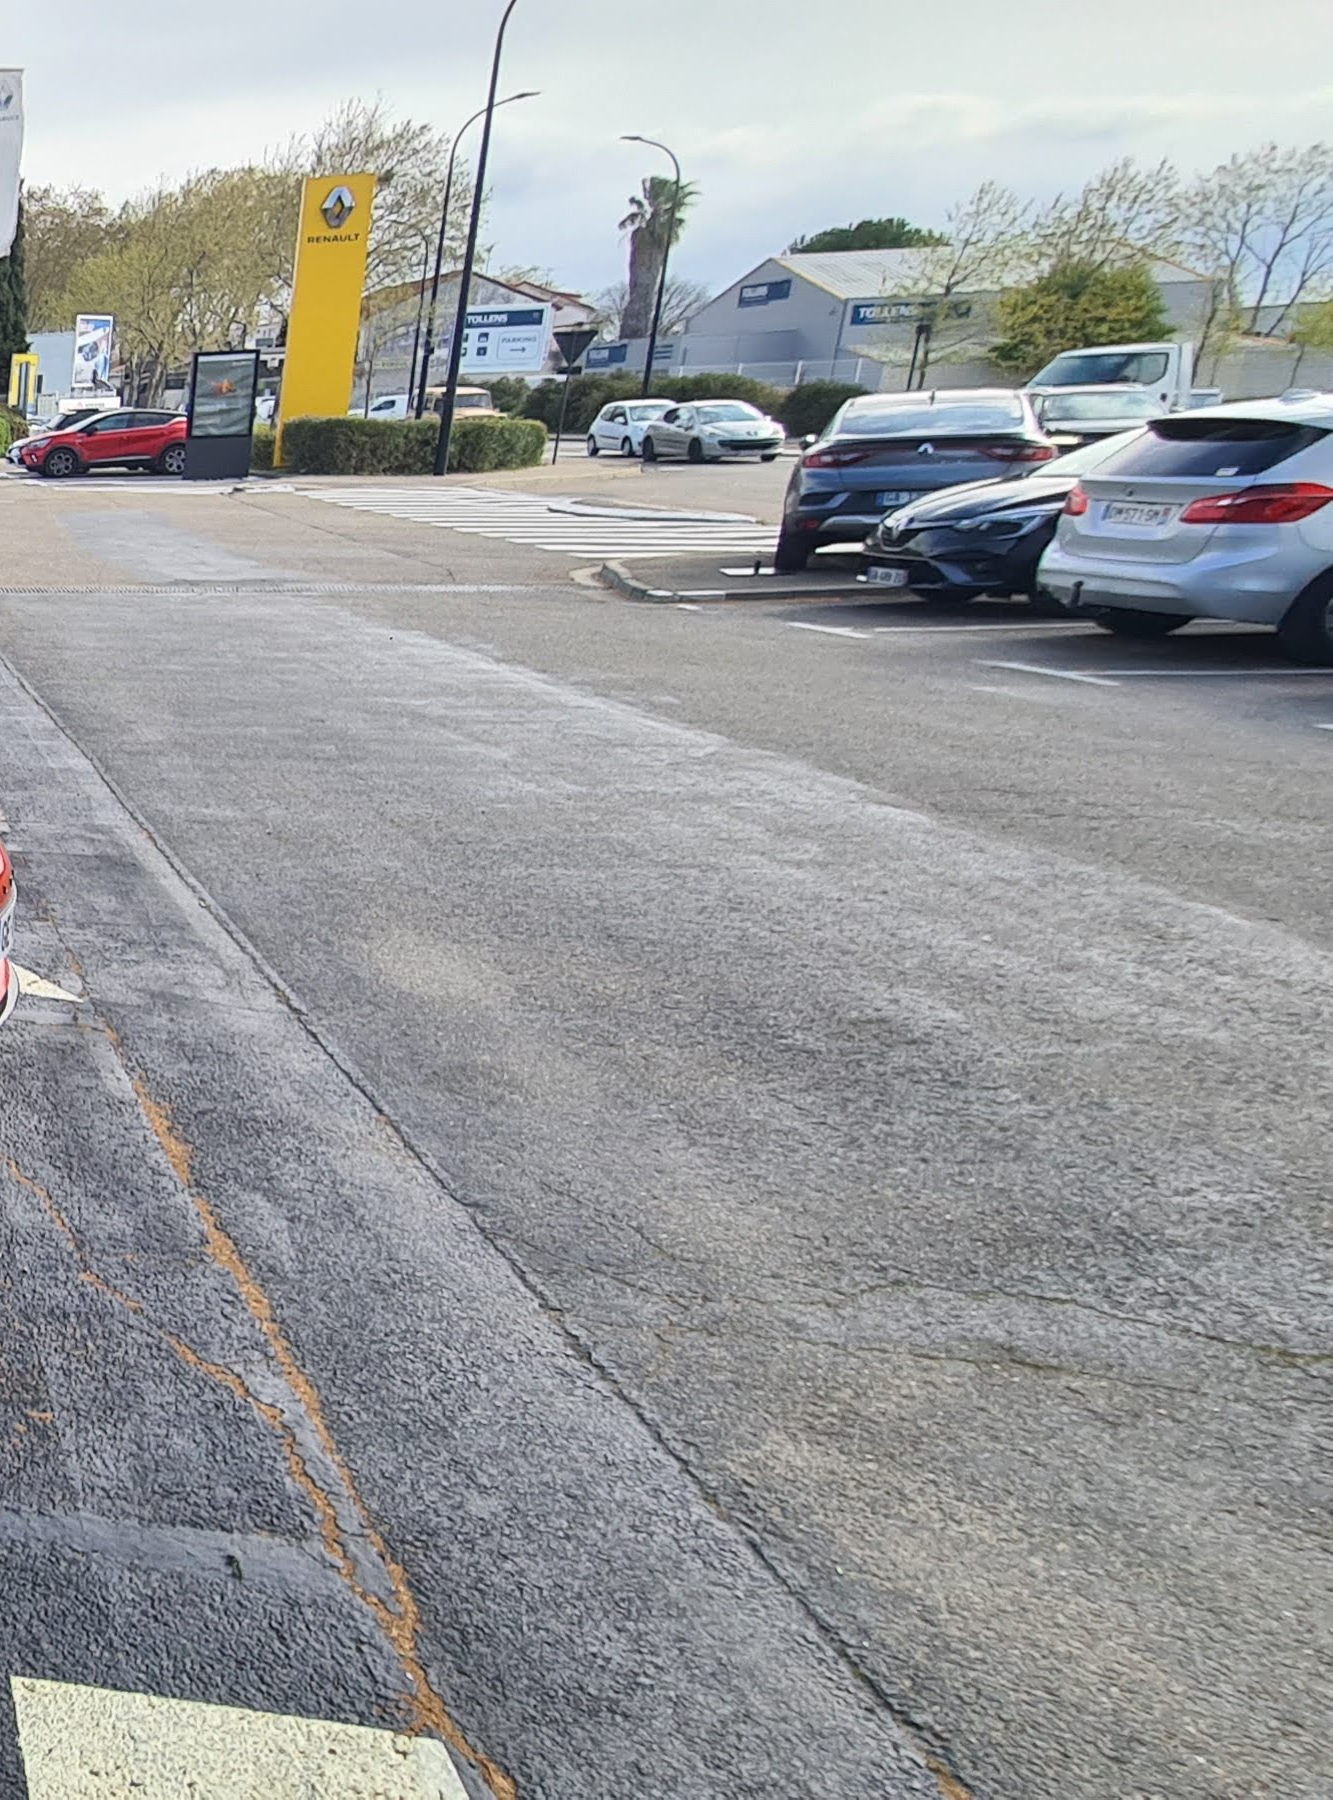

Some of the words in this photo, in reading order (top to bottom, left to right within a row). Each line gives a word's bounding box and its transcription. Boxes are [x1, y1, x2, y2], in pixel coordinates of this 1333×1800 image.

[307, 233, 360, 244] RENAULT
[466, 313, 509, 325] TOLLENS
[501, 336, 537, 344] PARKING
